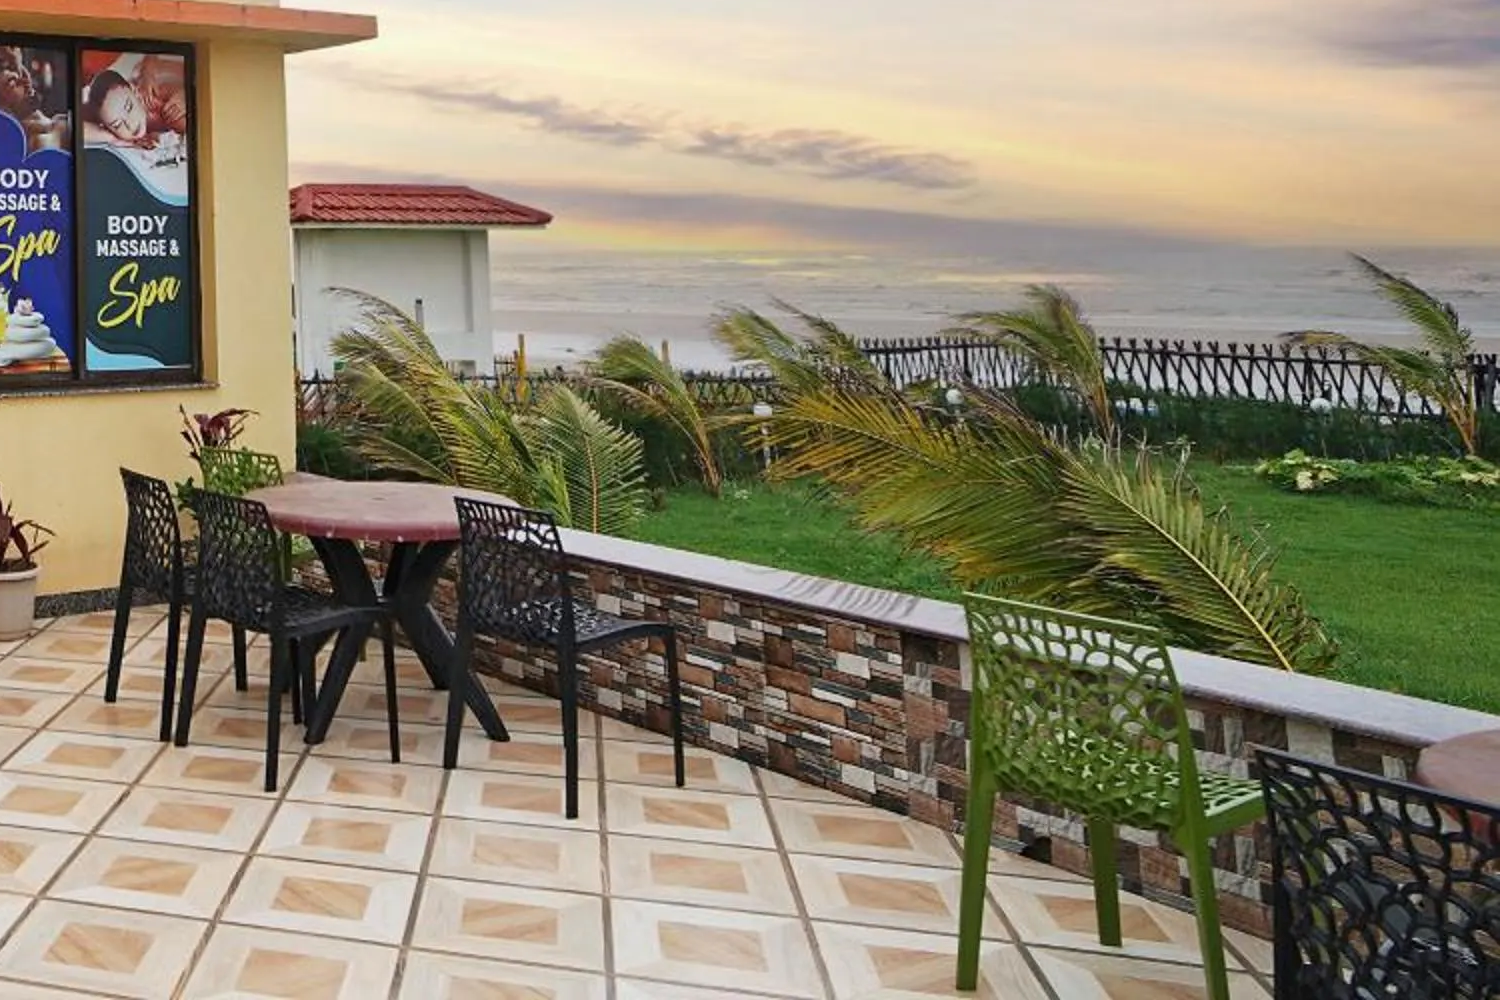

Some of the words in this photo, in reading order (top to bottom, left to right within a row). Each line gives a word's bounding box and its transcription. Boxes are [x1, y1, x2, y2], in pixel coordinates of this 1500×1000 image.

[50, 193, 61, 211] &
[107, 215, 169, 236] BODY
[96, 239, 168, 257] MASSAGE
[170, 239, 180, 257] &
[97, 260, 181, 329] Spa
